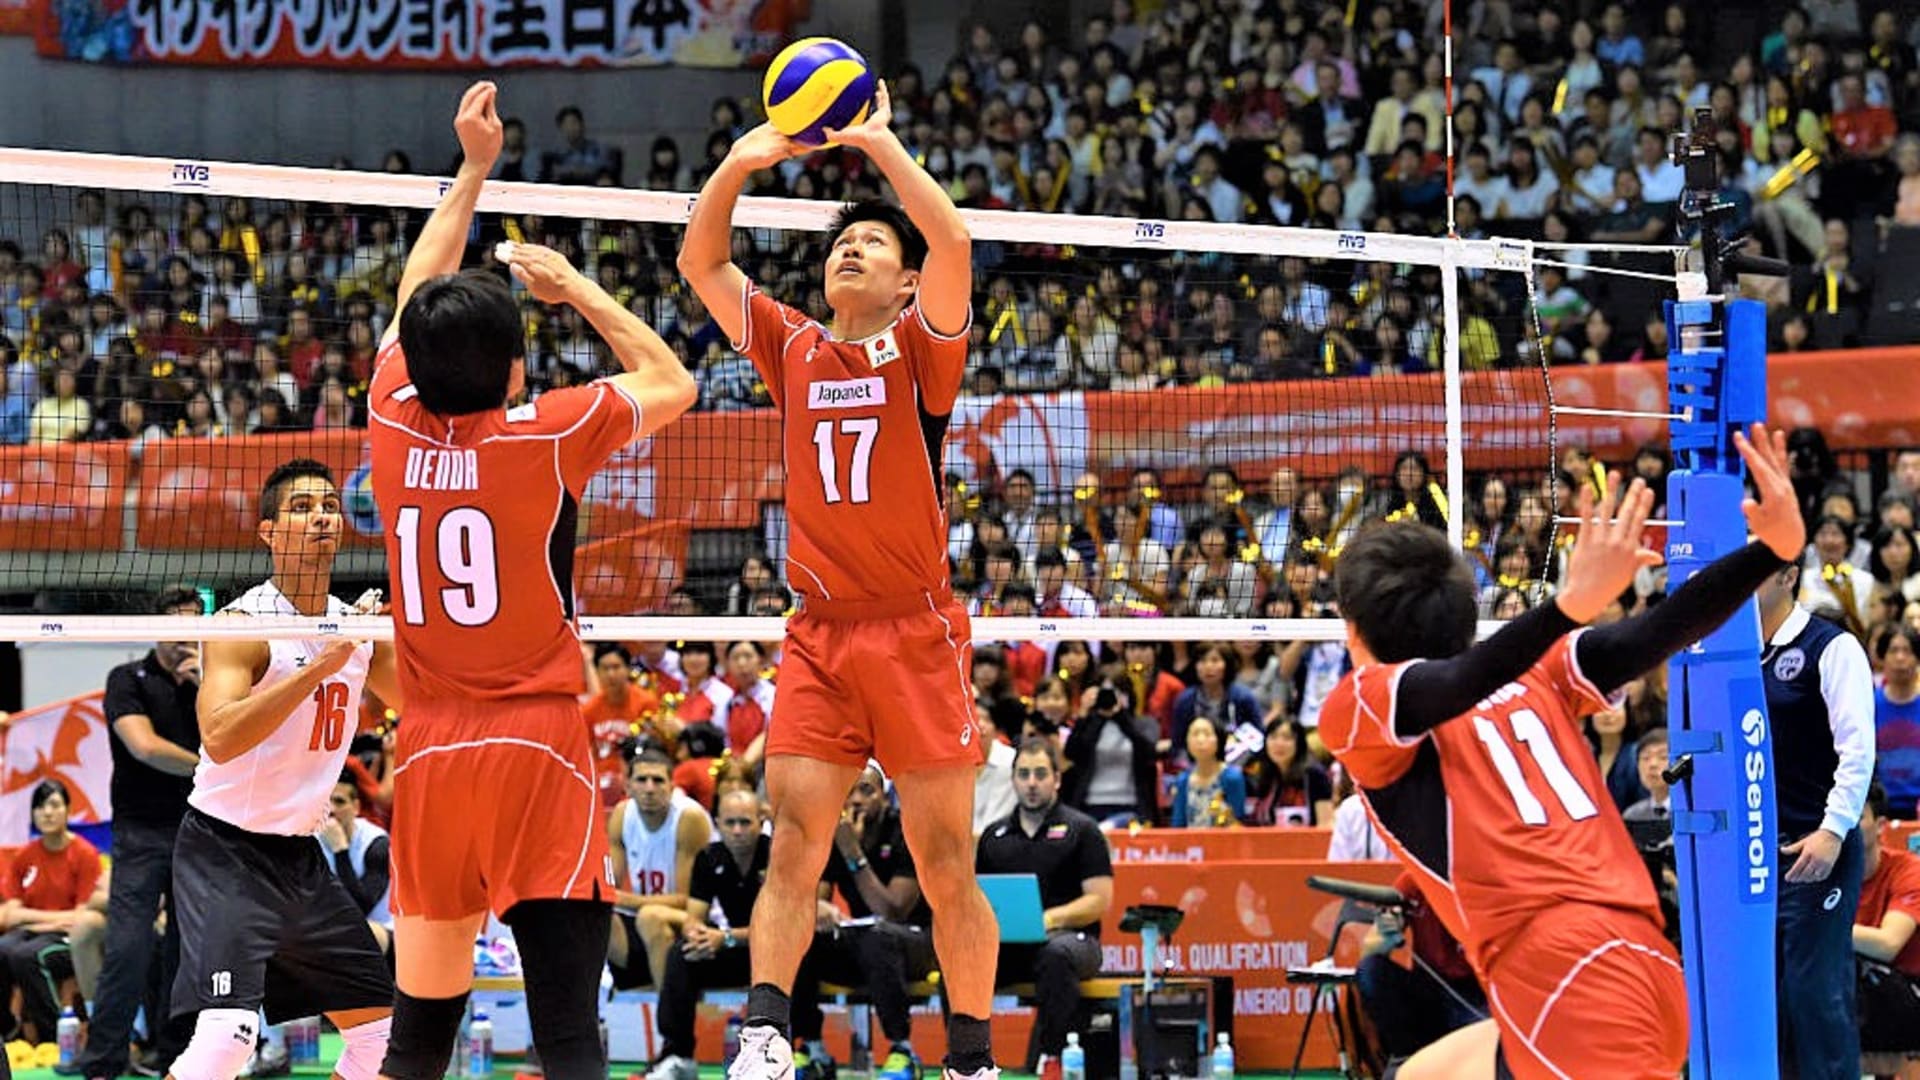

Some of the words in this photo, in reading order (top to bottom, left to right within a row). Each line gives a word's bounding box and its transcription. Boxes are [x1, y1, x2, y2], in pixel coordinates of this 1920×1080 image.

[172, 164, 209, 180] FIVB
[1135, 222, 1165, 237] FIVB
[1338, 233, 1366, 248] FIVB
[817, 384, 872, 404] Japanet
[404, 447, 479, 490] DENDA
[813, 416, 880, 504] 17
[395, 505, 500, 627] 19
[308, 681, 350, 752] 16
[1471, 708, 1599, 826] 11
[1745, 750, 1770, 895] Senoh
[1189, 941, 1308, 970] QUALIFICATION
